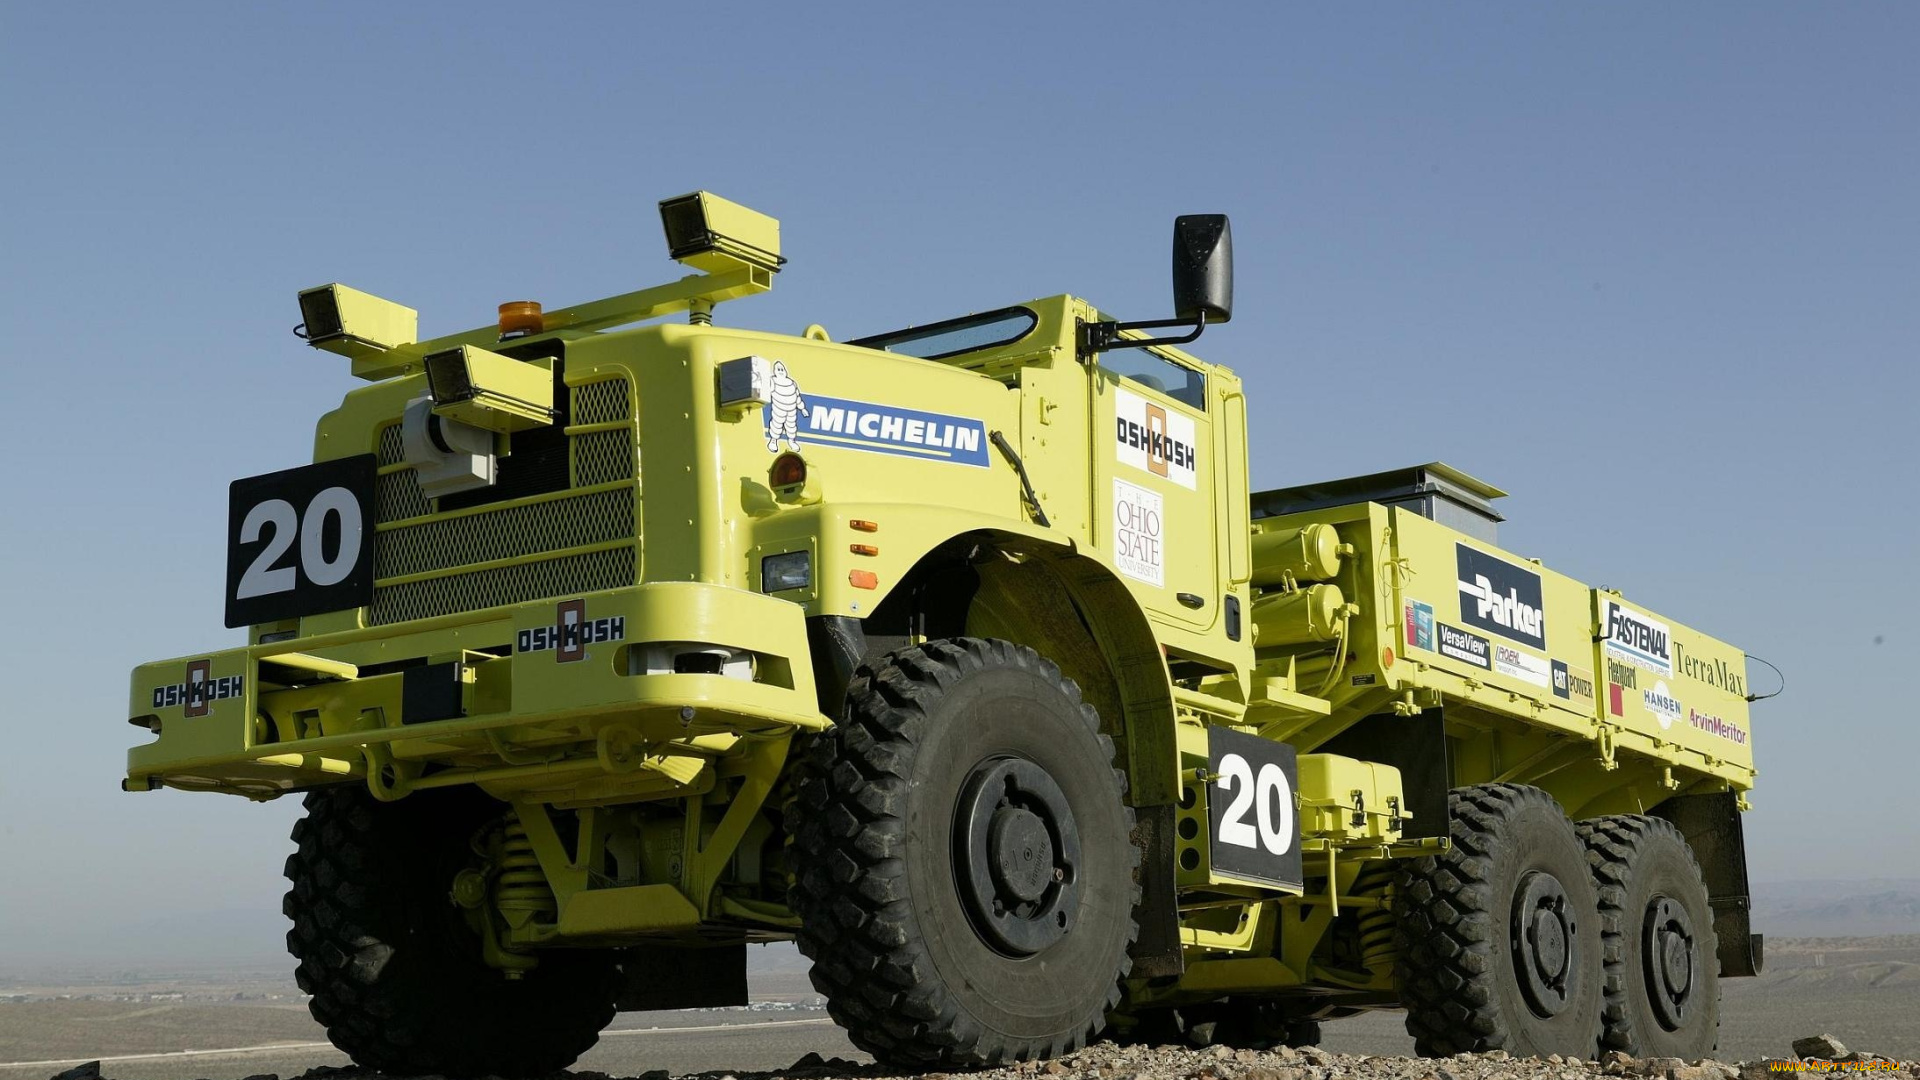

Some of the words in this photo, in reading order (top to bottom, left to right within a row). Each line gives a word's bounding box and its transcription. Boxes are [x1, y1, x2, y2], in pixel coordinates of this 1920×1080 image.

[810, 405, 980, 451] MICHELIN
[1117, 416, 1195, 471] OSHKOSH
[1117, 500, 1160, 537] OHIO
[236, 486, 363, 600] 20
[1118, 529, 1160, 567] STATE
[1118, 556, 1159, 579] UNIVERSITY
[1475, 573, 1542, 639] Parker
[518, 616, 625, 653] OSHKOSH
[1441, 625, 1485, 655] VersaView
[1608, 602, 1670, 660] FASTENAL
[1554, 668, 1566, 690] CAT
[1569, 675, 1594, 699] POWER
[1674, 642, 1744, 697] TerraMax
[153, 675, 243, 708] OSHKOSH
[1644, 689, 1681, 715] HANSEN
[1689, 707, 1747, 745] ArvinMeritor
[1217, 753, 1294, 856] 20
